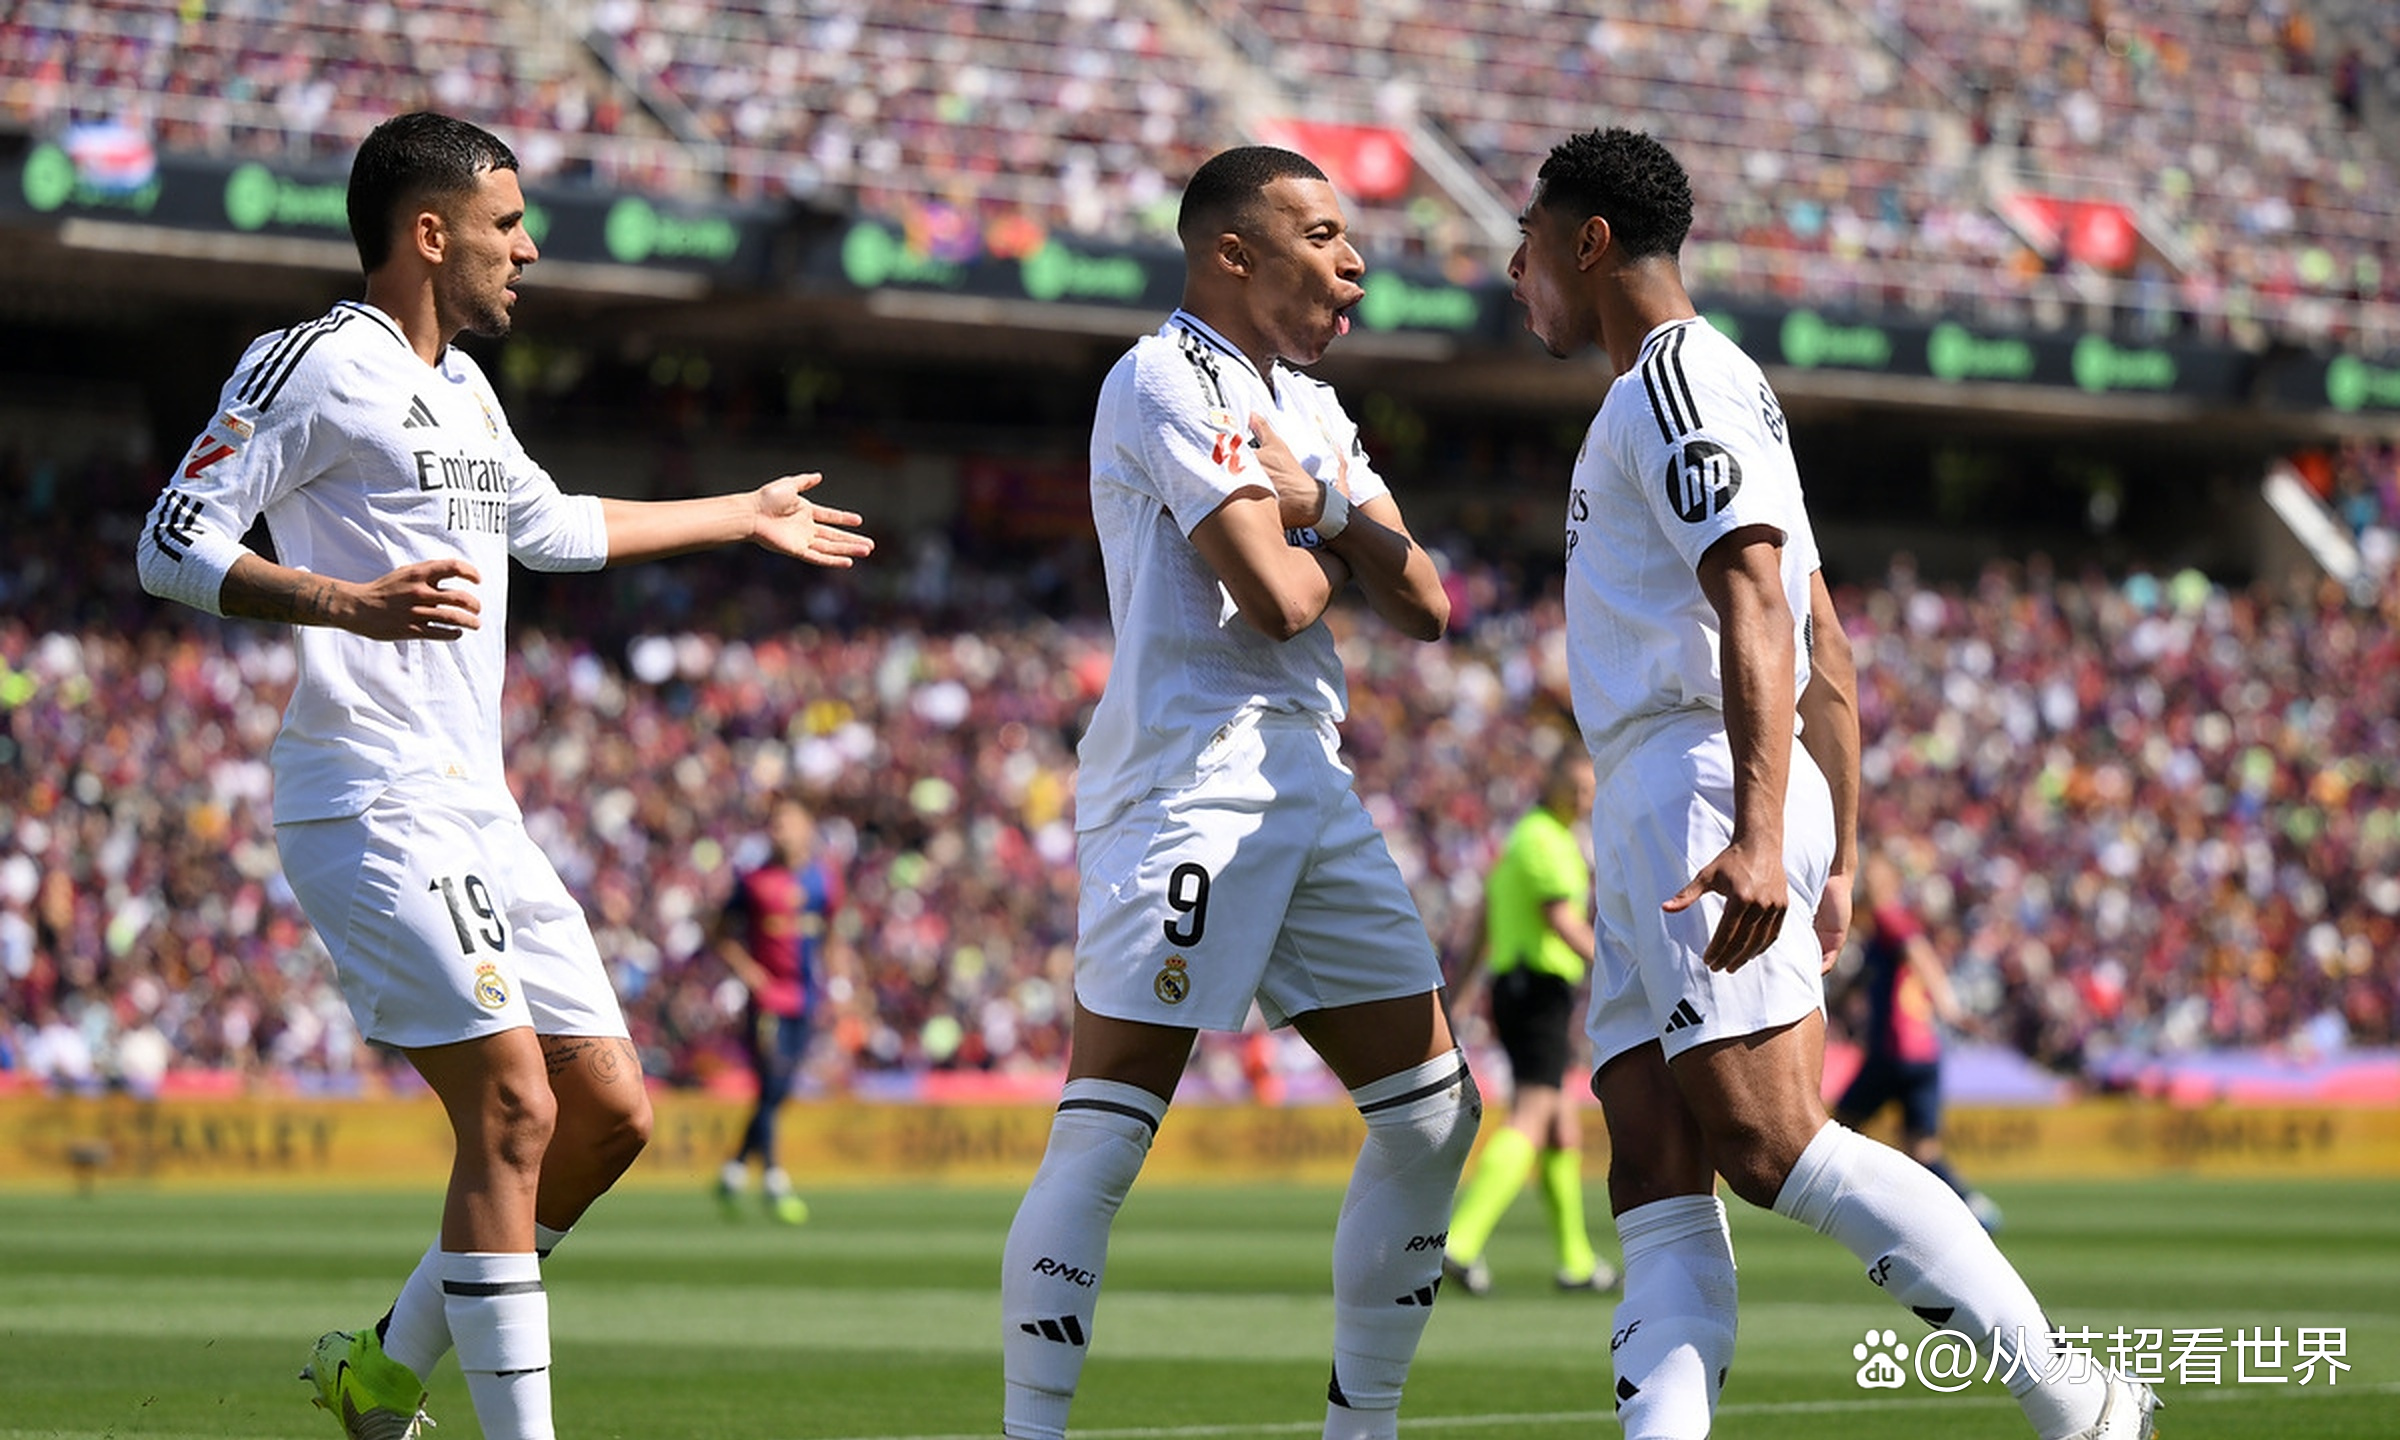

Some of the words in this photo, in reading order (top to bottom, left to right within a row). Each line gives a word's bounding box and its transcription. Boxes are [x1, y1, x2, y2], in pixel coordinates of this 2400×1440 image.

[1672, 440, 1732, 523] hp
[428, 874, 505, 955] 19
[1164, 862, 1210, 948] 9
